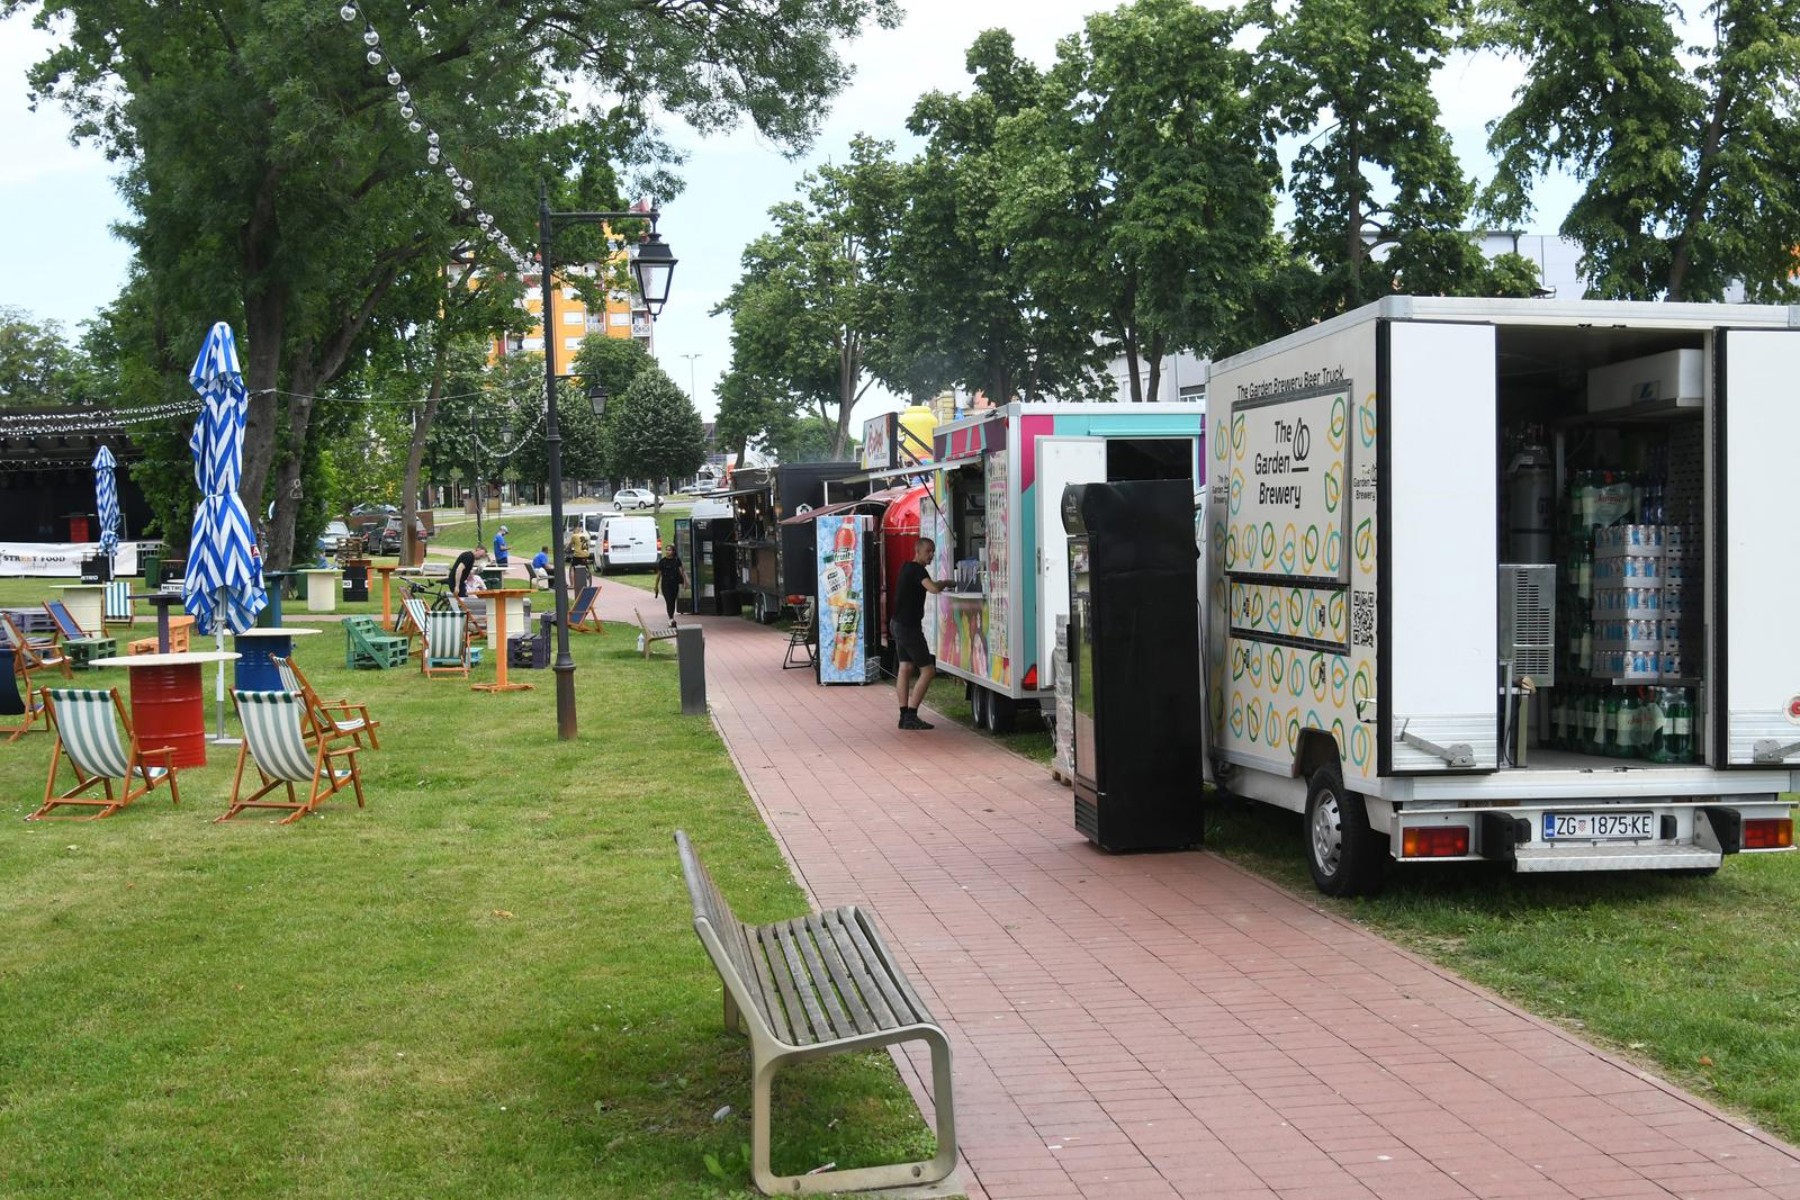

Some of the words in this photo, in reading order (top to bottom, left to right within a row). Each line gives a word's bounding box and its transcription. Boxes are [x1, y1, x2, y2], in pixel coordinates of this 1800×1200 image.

[1237, 385, 1249, 399] The
[1249, 380, 1273, 398] Garden
[1304, 372, 1320, 388] Beer
[1322, 364, 1345, 385] Truck
[1274, 420, 1292, 444] The
[1254, 450, 1291, 475] Garden
[1258, 482, 1302, 509] Brewery
[3, 554, 37, 563] STREET
[1556, 816, 1577, 835] ZG
